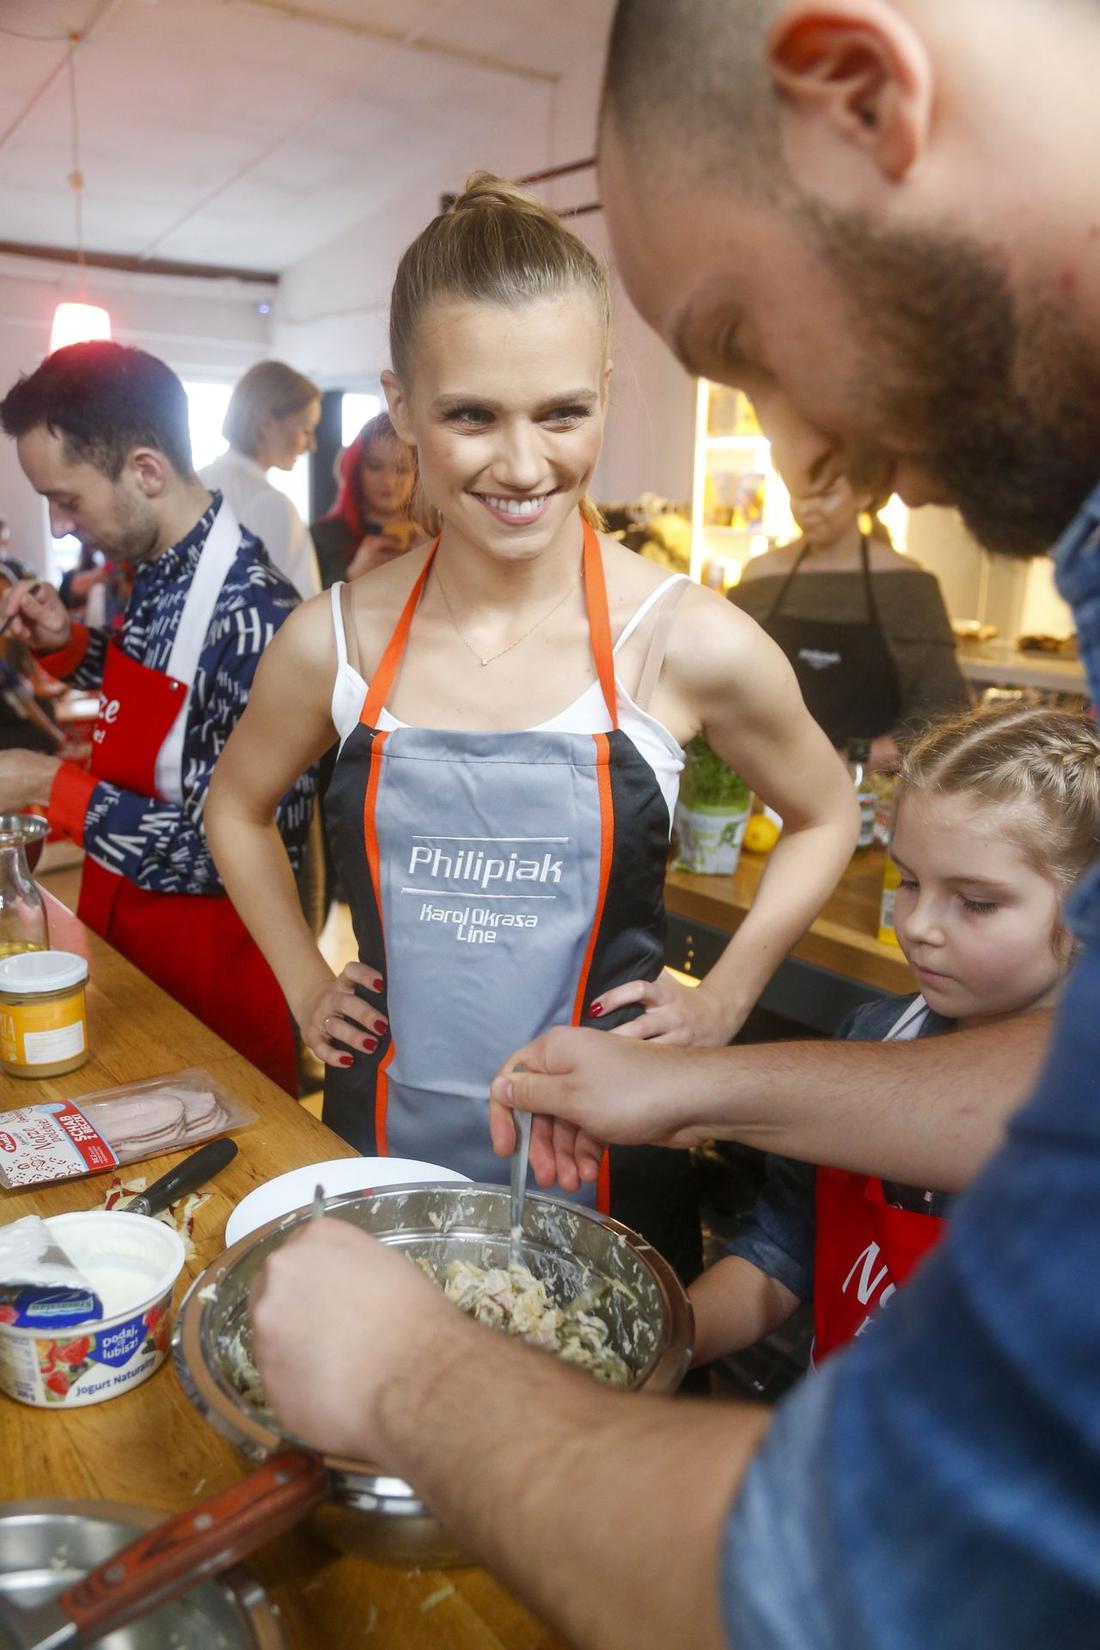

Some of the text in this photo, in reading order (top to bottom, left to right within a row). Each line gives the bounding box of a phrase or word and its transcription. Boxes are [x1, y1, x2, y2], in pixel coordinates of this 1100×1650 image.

[408, 846, 563, 888] Philipiak
[420, 904, 538, 928] Karol Okrasa
[456, 924, 497, 944] Line
[60, 1115, 88, 1142] SCHAB
[71, 1114, 95, 1134] BECZKI
